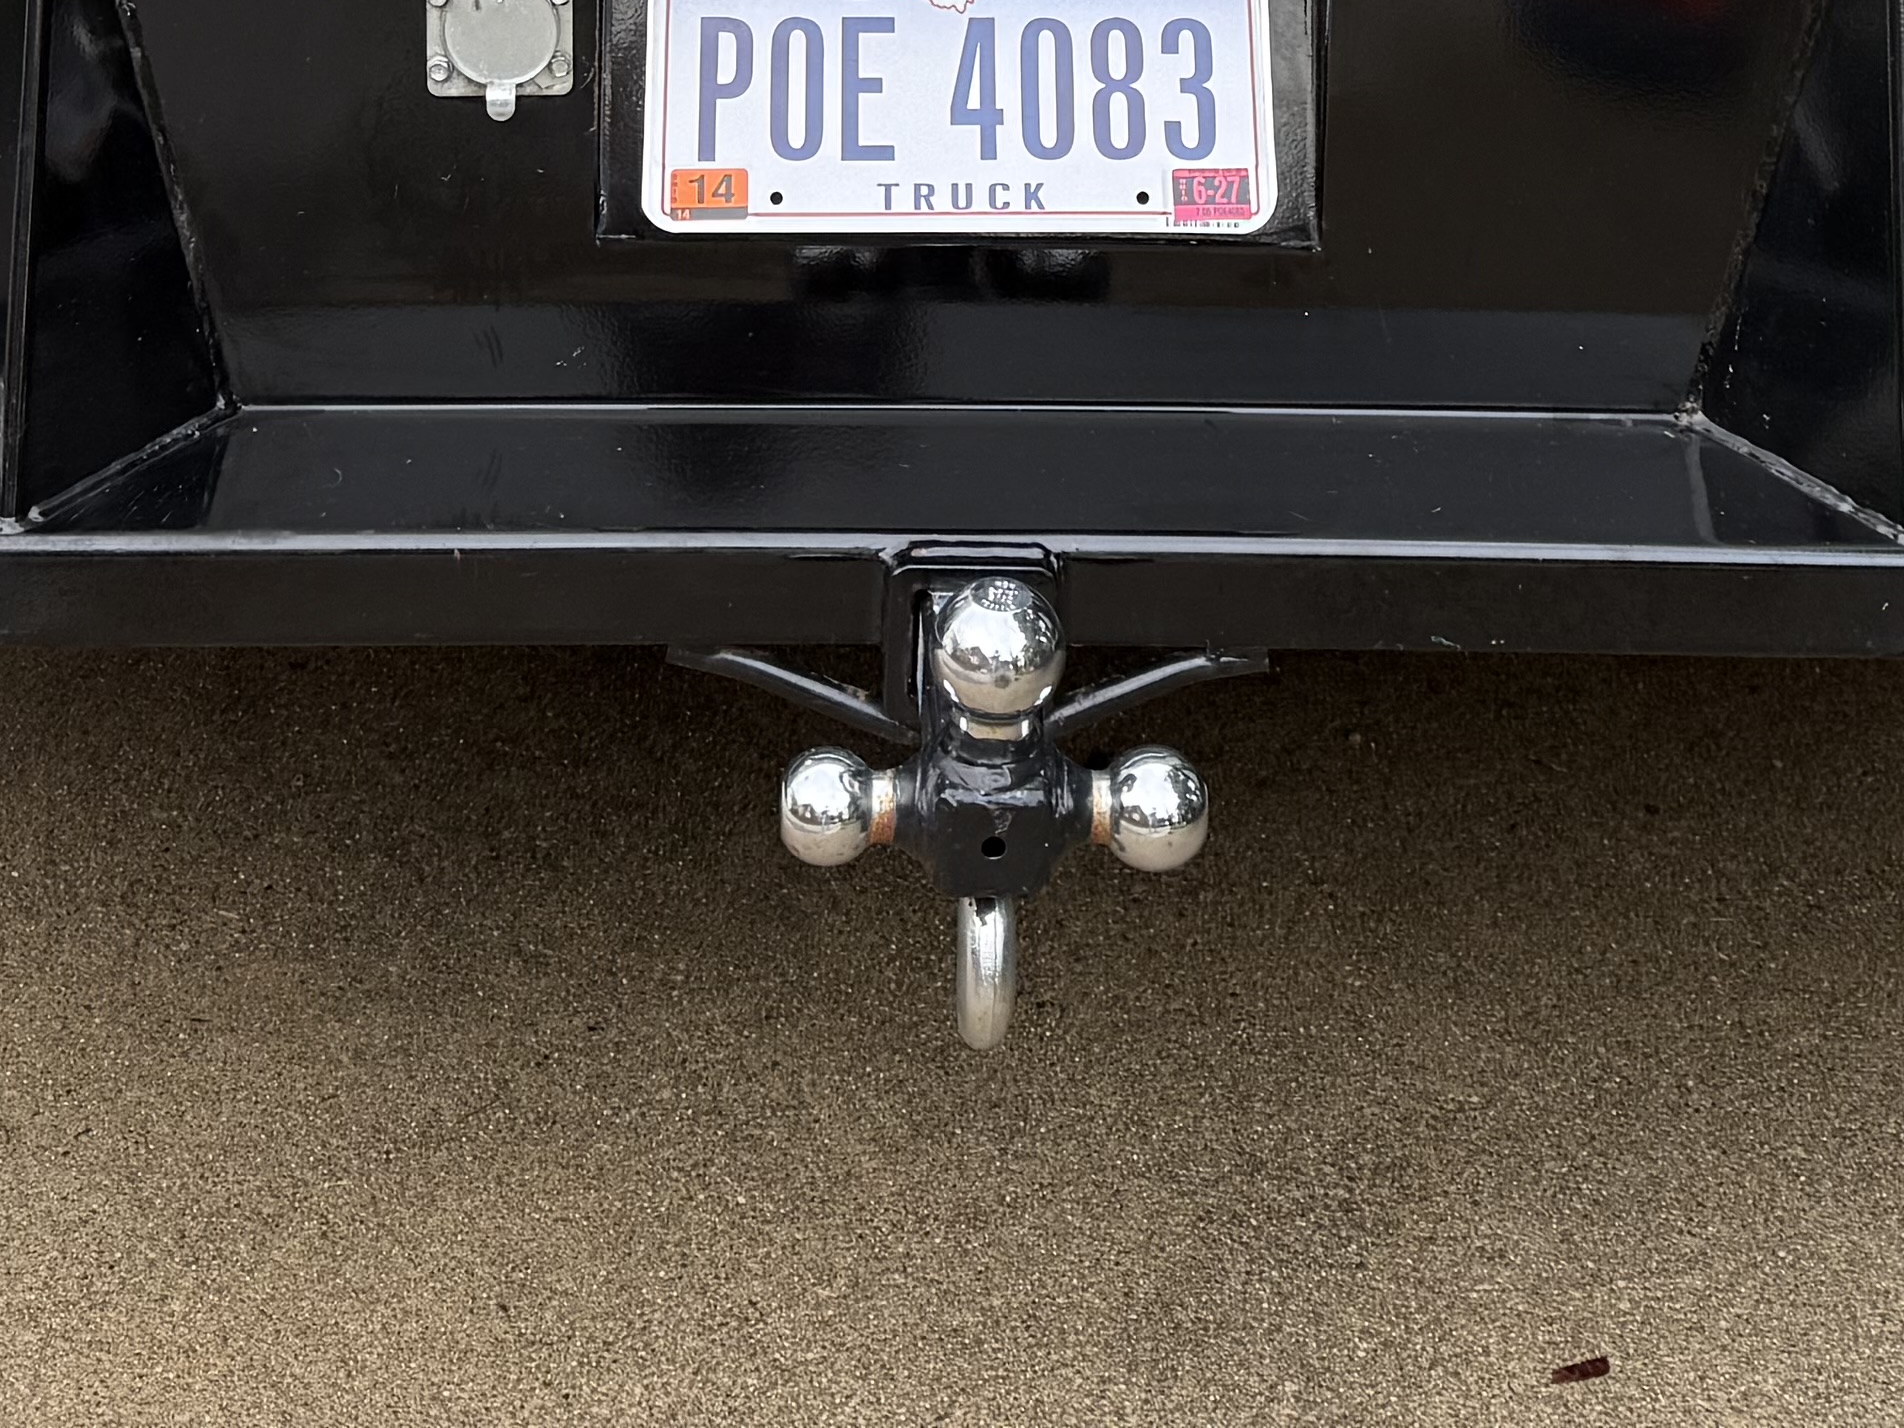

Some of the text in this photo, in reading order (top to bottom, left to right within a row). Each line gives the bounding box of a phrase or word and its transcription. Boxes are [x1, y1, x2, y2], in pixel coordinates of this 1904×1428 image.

[698, 17, 1217, 162] POE 4083
[688, 174, 736, 204] 14
[876, 182, 1045, 211] TRUCK
[1193, 176, 1240, 204] 6-27
